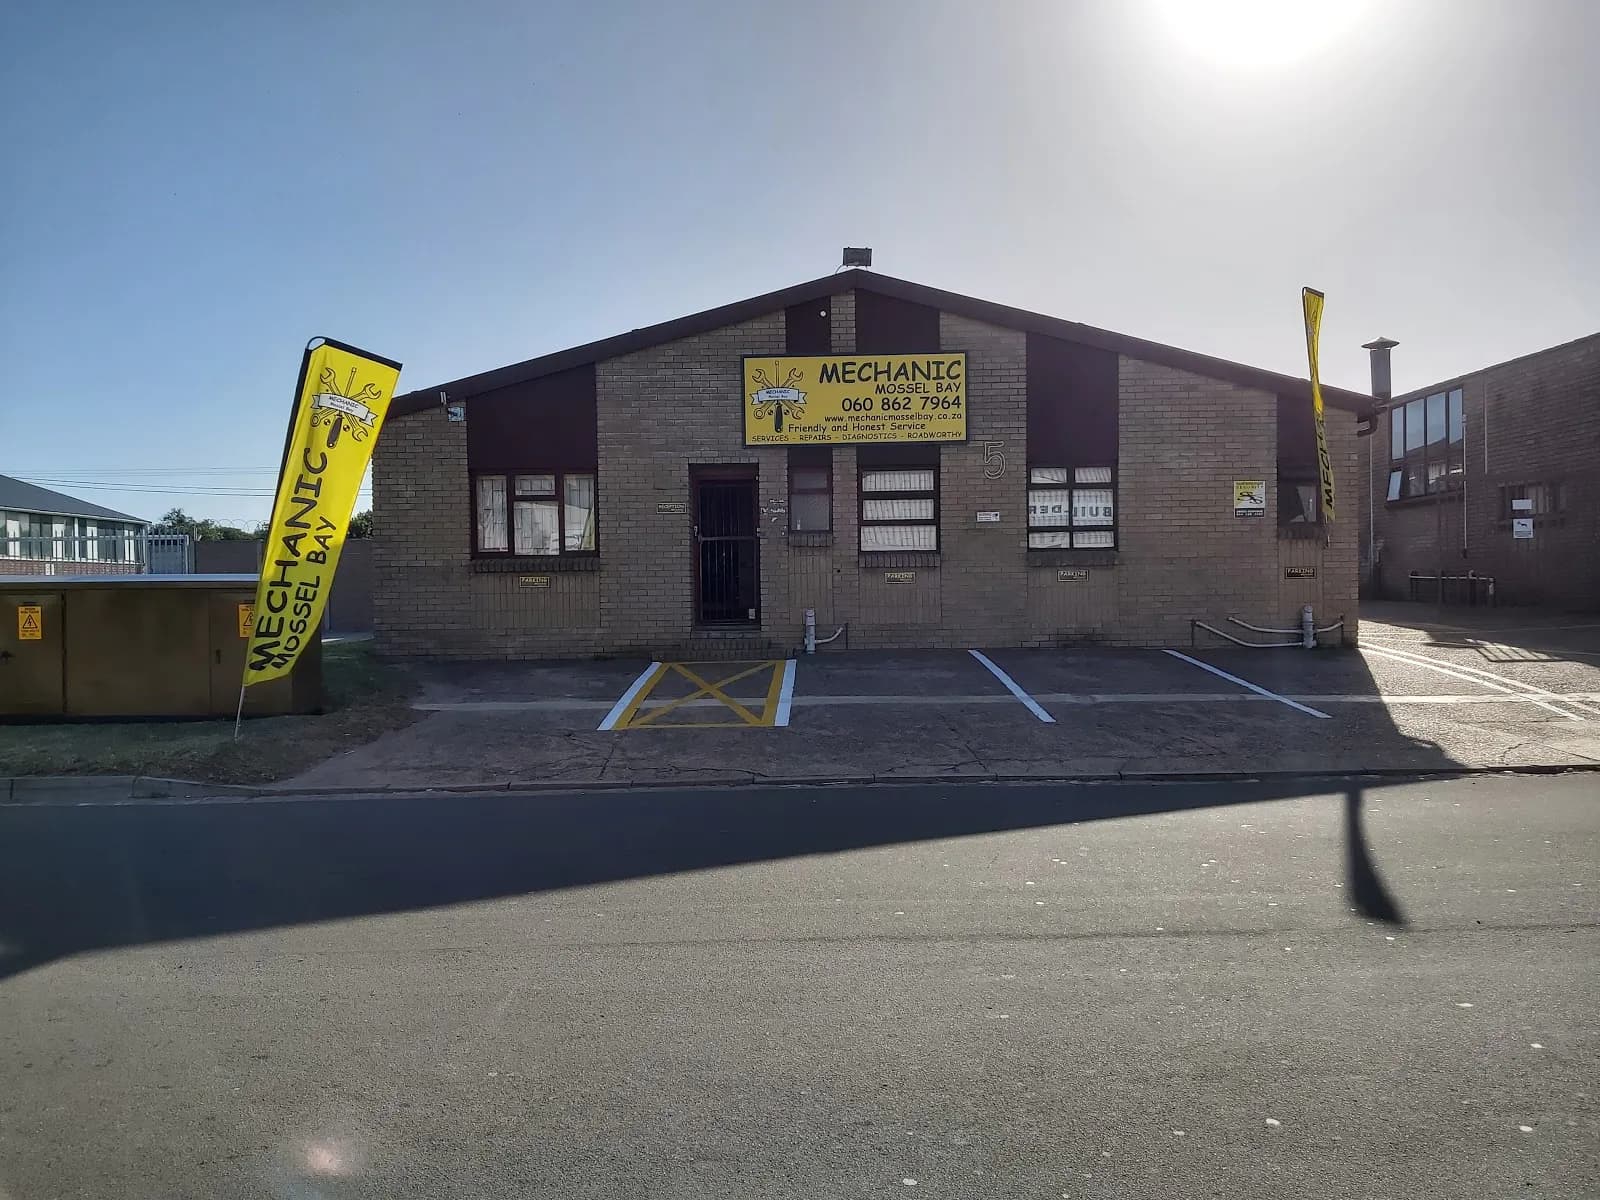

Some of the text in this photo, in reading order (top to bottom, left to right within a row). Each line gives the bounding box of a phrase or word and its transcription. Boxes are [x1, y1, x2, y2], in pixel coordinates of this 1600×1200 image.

[819, 360, 962, 384] MECHANIC
[875, 382, 962, 394] MOSSEL BAY
[841, 395, 962, 412] 060 862 7964
[824, 412, 962, 423] www.mechanicmosselbay.co.za
[788, 421, 926, 434] Friendly and Honest Service
[751, 434, 789, 442] SERVICES
[799, 433, 832, 441] REPAIRS
[842, 432, 897, 441] DIAGNOSTICS
[907, 431, 962, 440] ROADWORTHY
[984, 441, 1006, 480] 5
[249, 447, 328, 672] MECHANIC
[271, 516, 337, 669] MOSSEL BAY
